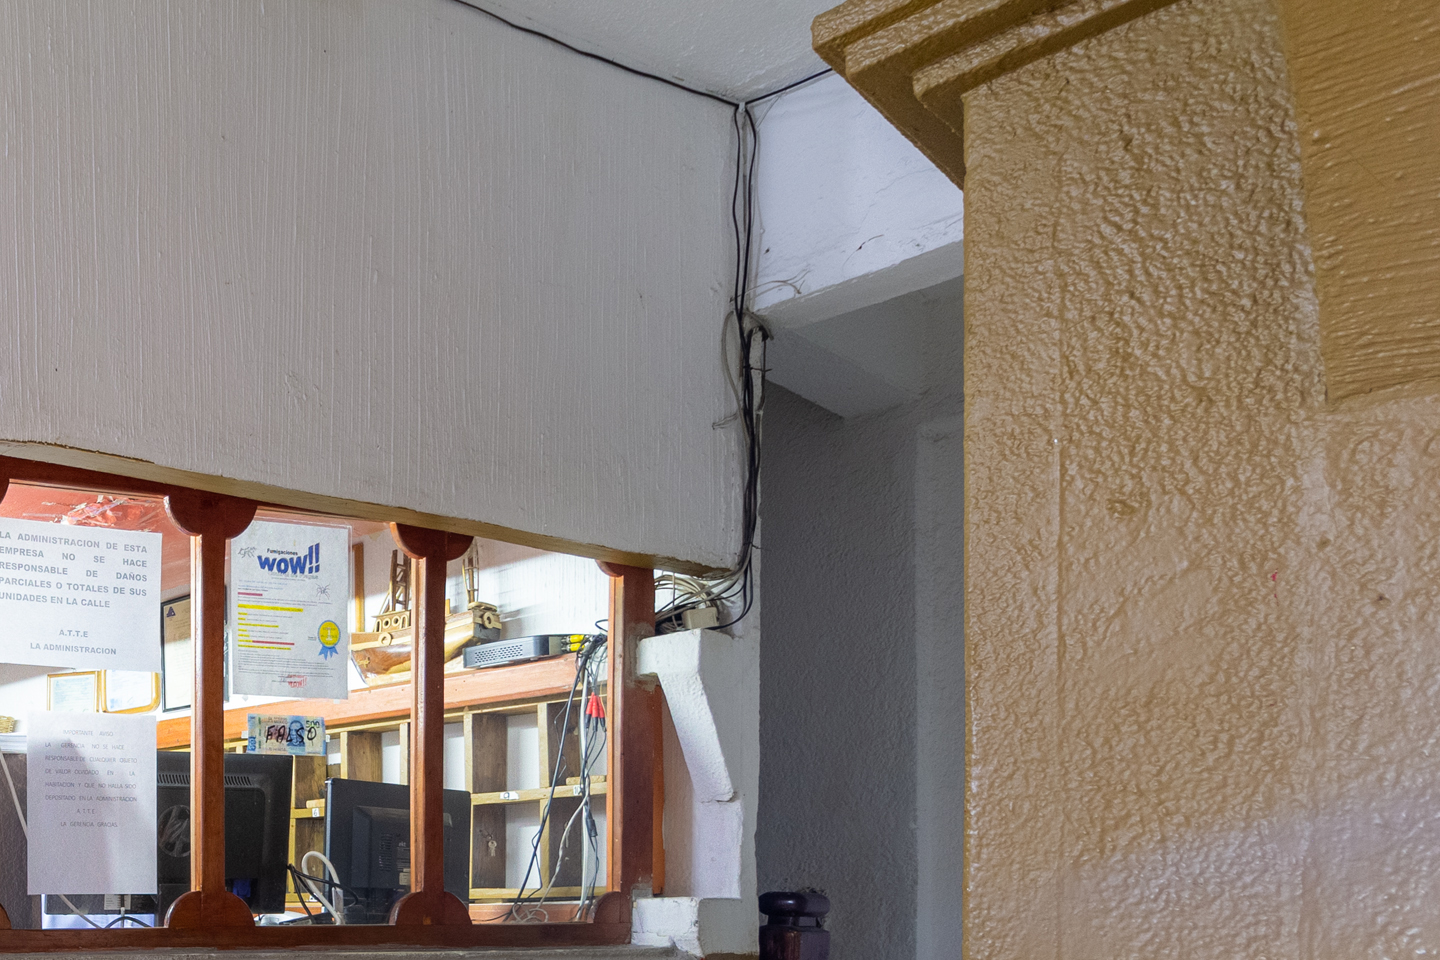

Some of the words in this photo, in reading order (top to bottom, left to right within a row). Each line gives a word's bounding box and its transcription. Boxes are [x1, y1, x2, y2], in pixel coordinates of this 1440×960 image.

[0, 531, 11, 539] LA
[18, 533, 100, 548] ADMINISTRACION
[106, 542, 118, 550] DE
[124, 544, 147, 553] ESTA
[0, 546, 44, 557] EMPRESA
[123, 558, 147, 567] HACE
[0, 562, 68, 575] RESPONSABLE
[116, 572, 147, 582] DAÑOS
[0, 577, 51, 588] PARCIALES
[67, 583, 109, 593] TOTALES
[129, 588, 147, 596] SUS
[0, 592, 47, 603] UNIDADES
[81, 599, 110, 608] CALLE
[43, 644, 116, 655] ADMINISTRACION
[266, 725, 317, 744] FALSO
